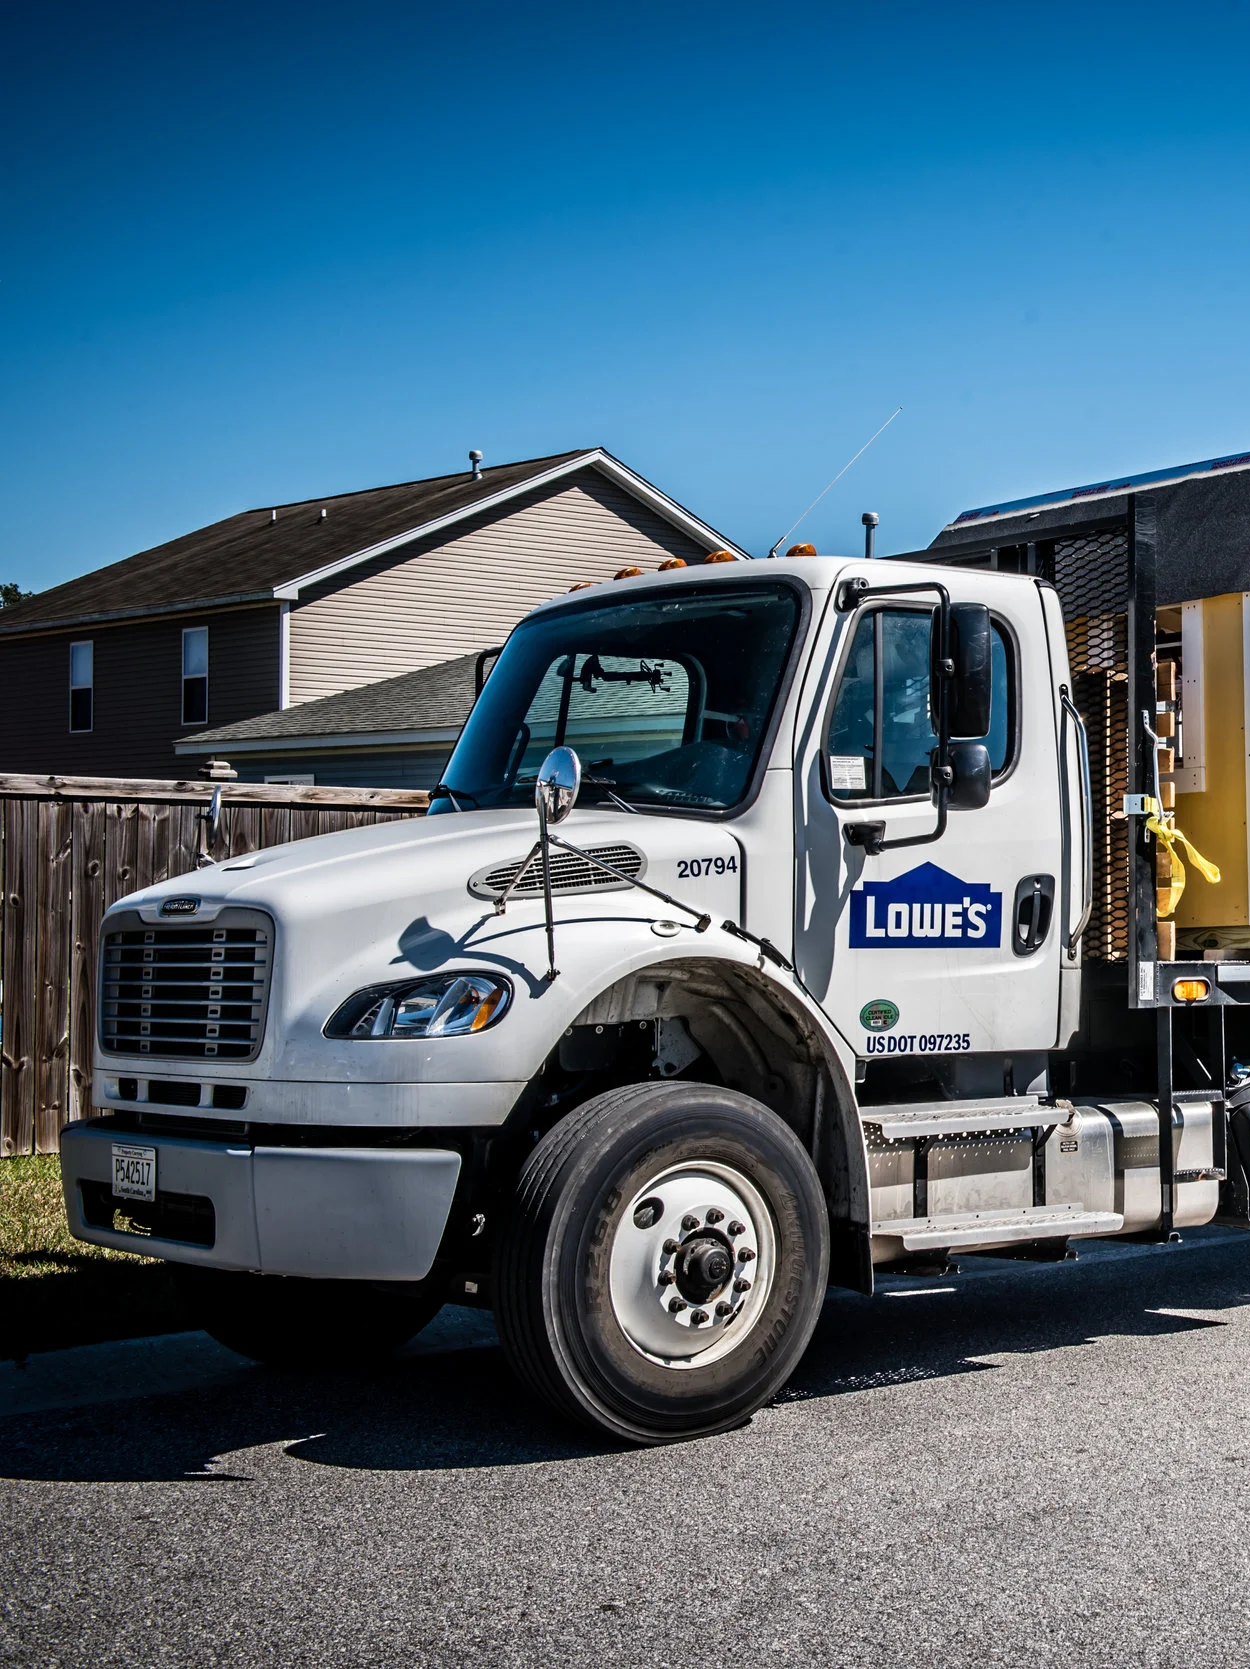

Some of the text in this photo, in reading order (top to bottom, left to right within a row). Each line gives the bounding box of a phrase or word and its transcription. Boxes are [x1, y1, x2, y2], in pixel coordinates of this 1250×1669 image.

[677, 855, 738, 879] 20794
[865, 895, 988, 939] LOWE'S
[918, 1033, 971, 1052] 097235
[115, 1158, 151, 1186] P542517
[752, 1190, 806, 1368] BRIDGESTONE
